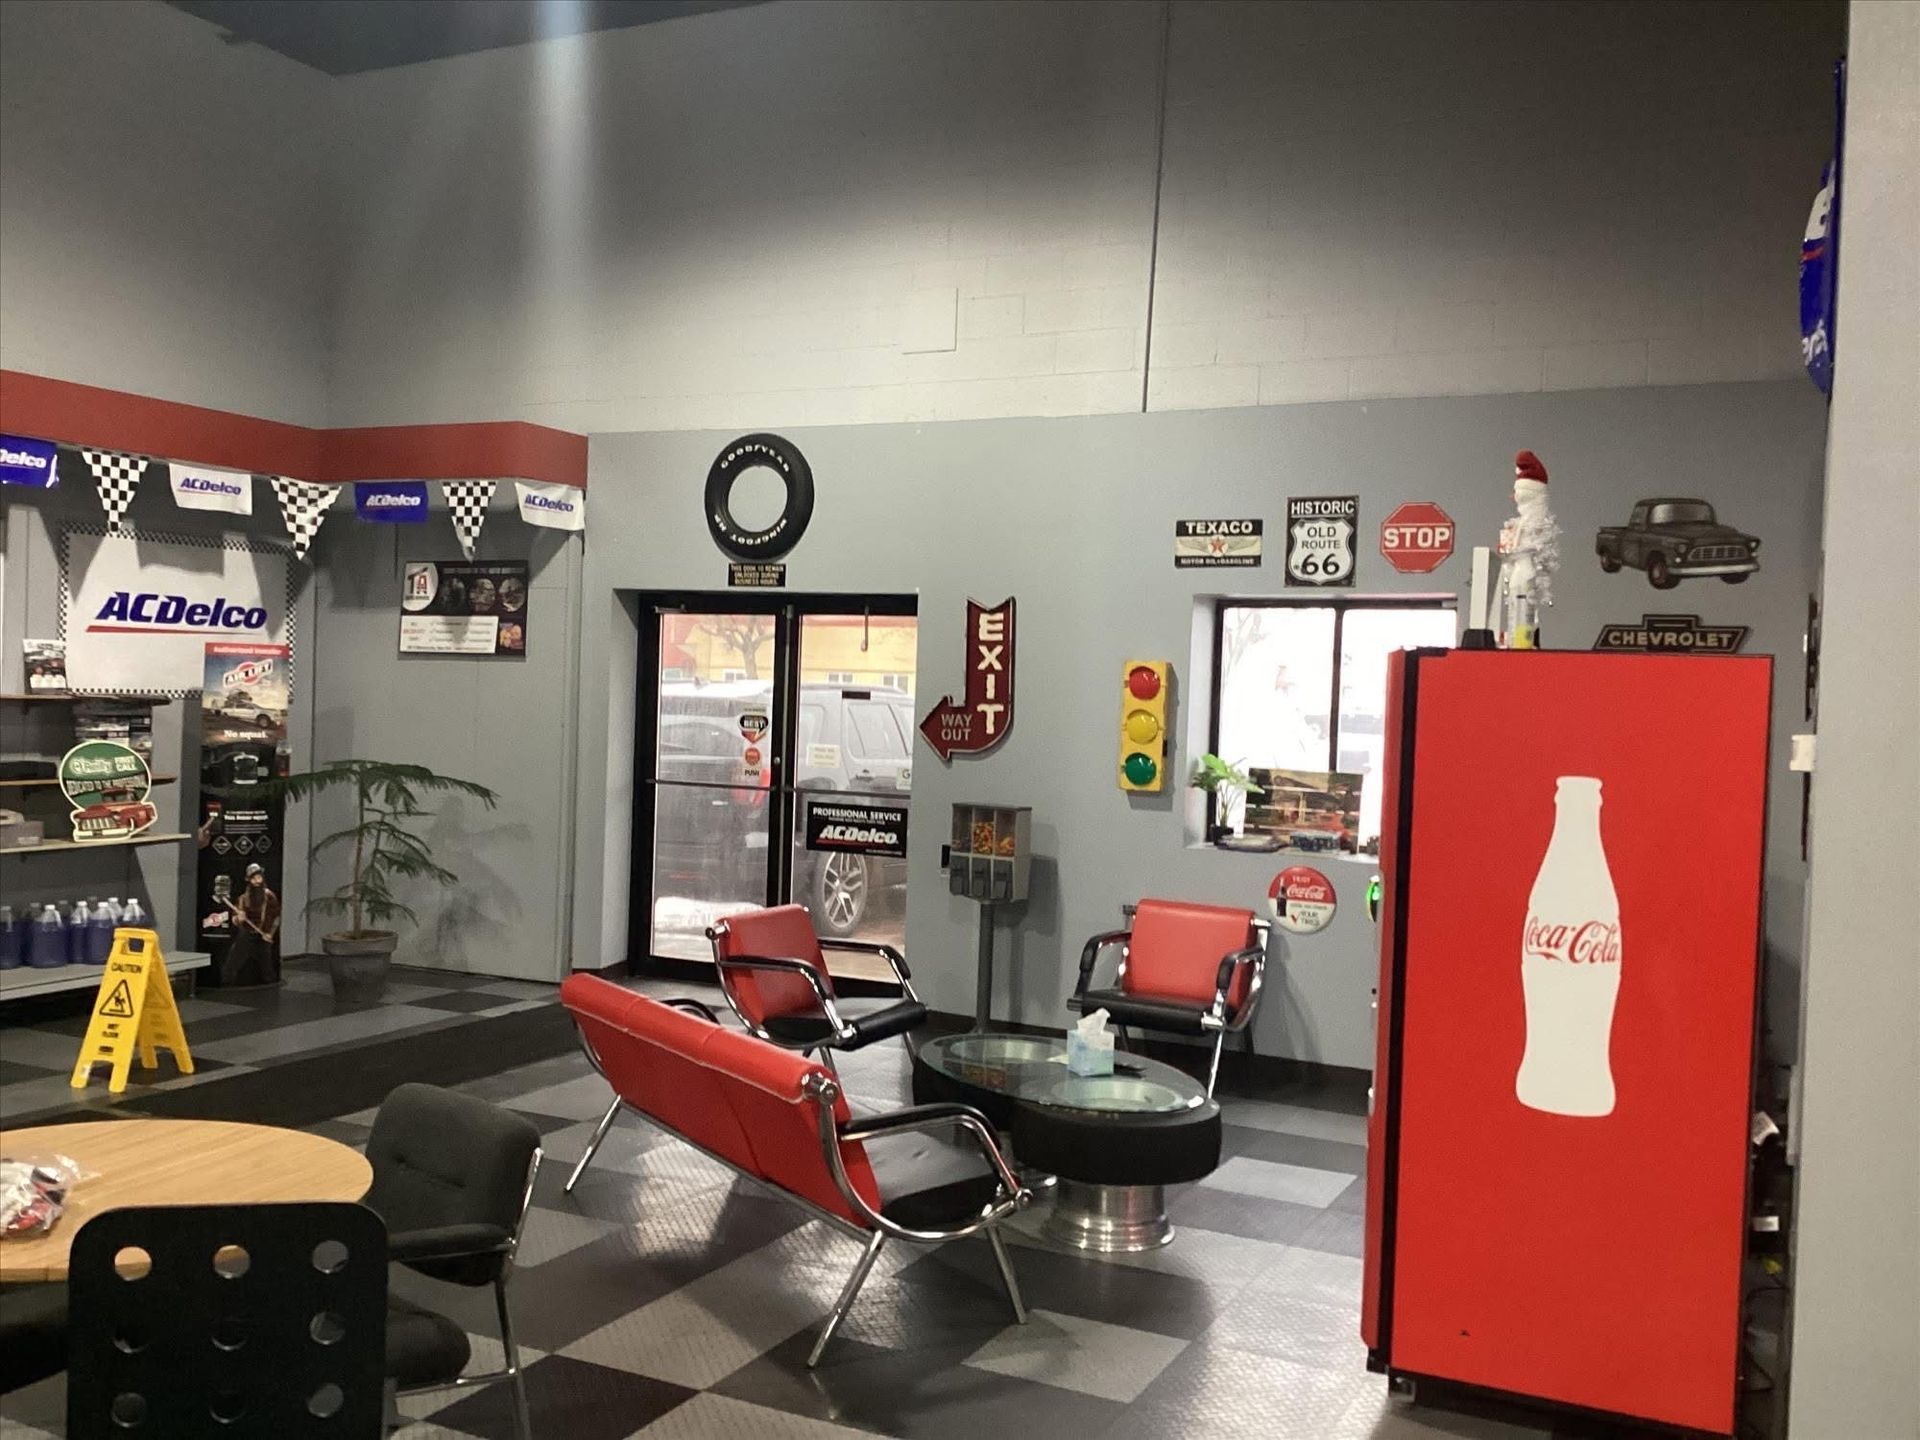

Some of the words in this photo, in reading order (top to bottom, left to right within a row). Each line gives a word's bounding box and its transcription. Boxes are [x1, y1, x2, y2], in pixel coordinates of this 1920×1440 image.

[721, 444, 789, 472] GOODYEAR
[180, 477, 242, 495] ACDelco
[366, 494, 421, 507] ACDelco
[524, 493, 574, 512] ACDelco
[1291, 500, 1355, 515] HISTORIC
[1185, 521, 1253, 534] TEXACO
[1307, 526, 1337, 538] OLD
[1301, 539, 1341, 550] ROUTE
[1384, 527, 1450, 548] STOP
[1301, 553, 1340, 576] 66
[95, 592, 268, 629] ACDelco
[1608, 631, 1733, 647] CHEVROLET
[977, 612, 1004, 735] EXIT
[941, 714, 972, 728] WAY
[224, 730, 238, 738] No
[941, 728, 971, 741] OUT
[813, 807, 868, 819] PROFESSIONAL
[870, 810, 901, 821] SERVICE
[820, 824, 897, 844] ACDelco
[1287, 884, 1327, 899] Coca-Cola
[111, 963, 142, 973] CAUTION
